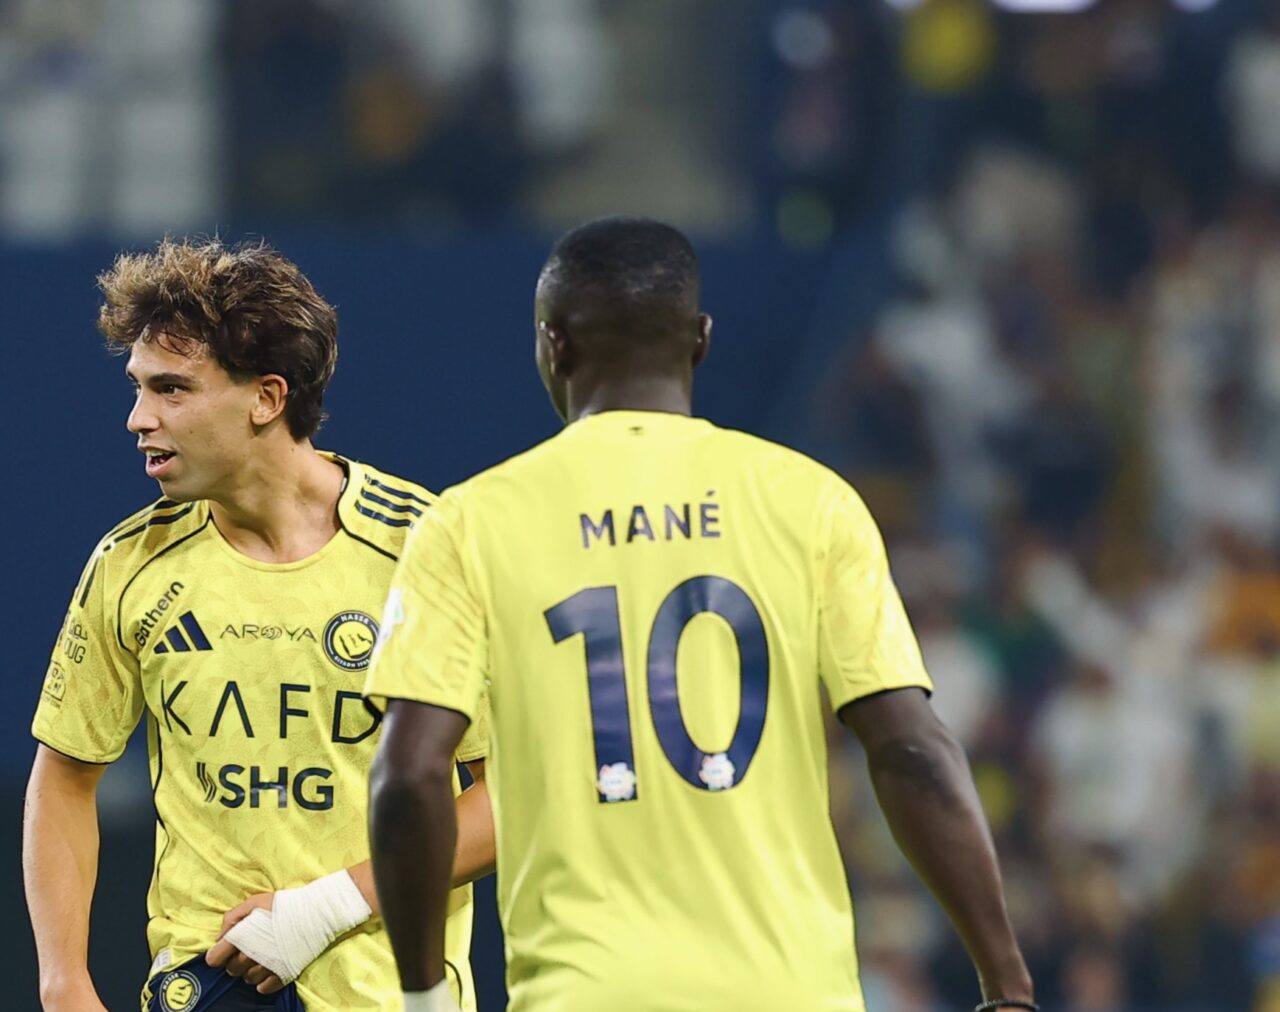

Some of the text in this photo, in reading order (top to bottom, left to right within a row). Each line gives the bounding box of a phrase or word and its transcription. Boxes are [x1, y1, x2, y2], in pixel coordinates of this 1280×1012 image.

[580, 491, 721, 549] MANÉ
[134, 581, 185, 647] Gathern
[160, 680, 382, 744] KAFD
[543, 575, 770, 804] 10
[219, 763, 335, 812] SHG
